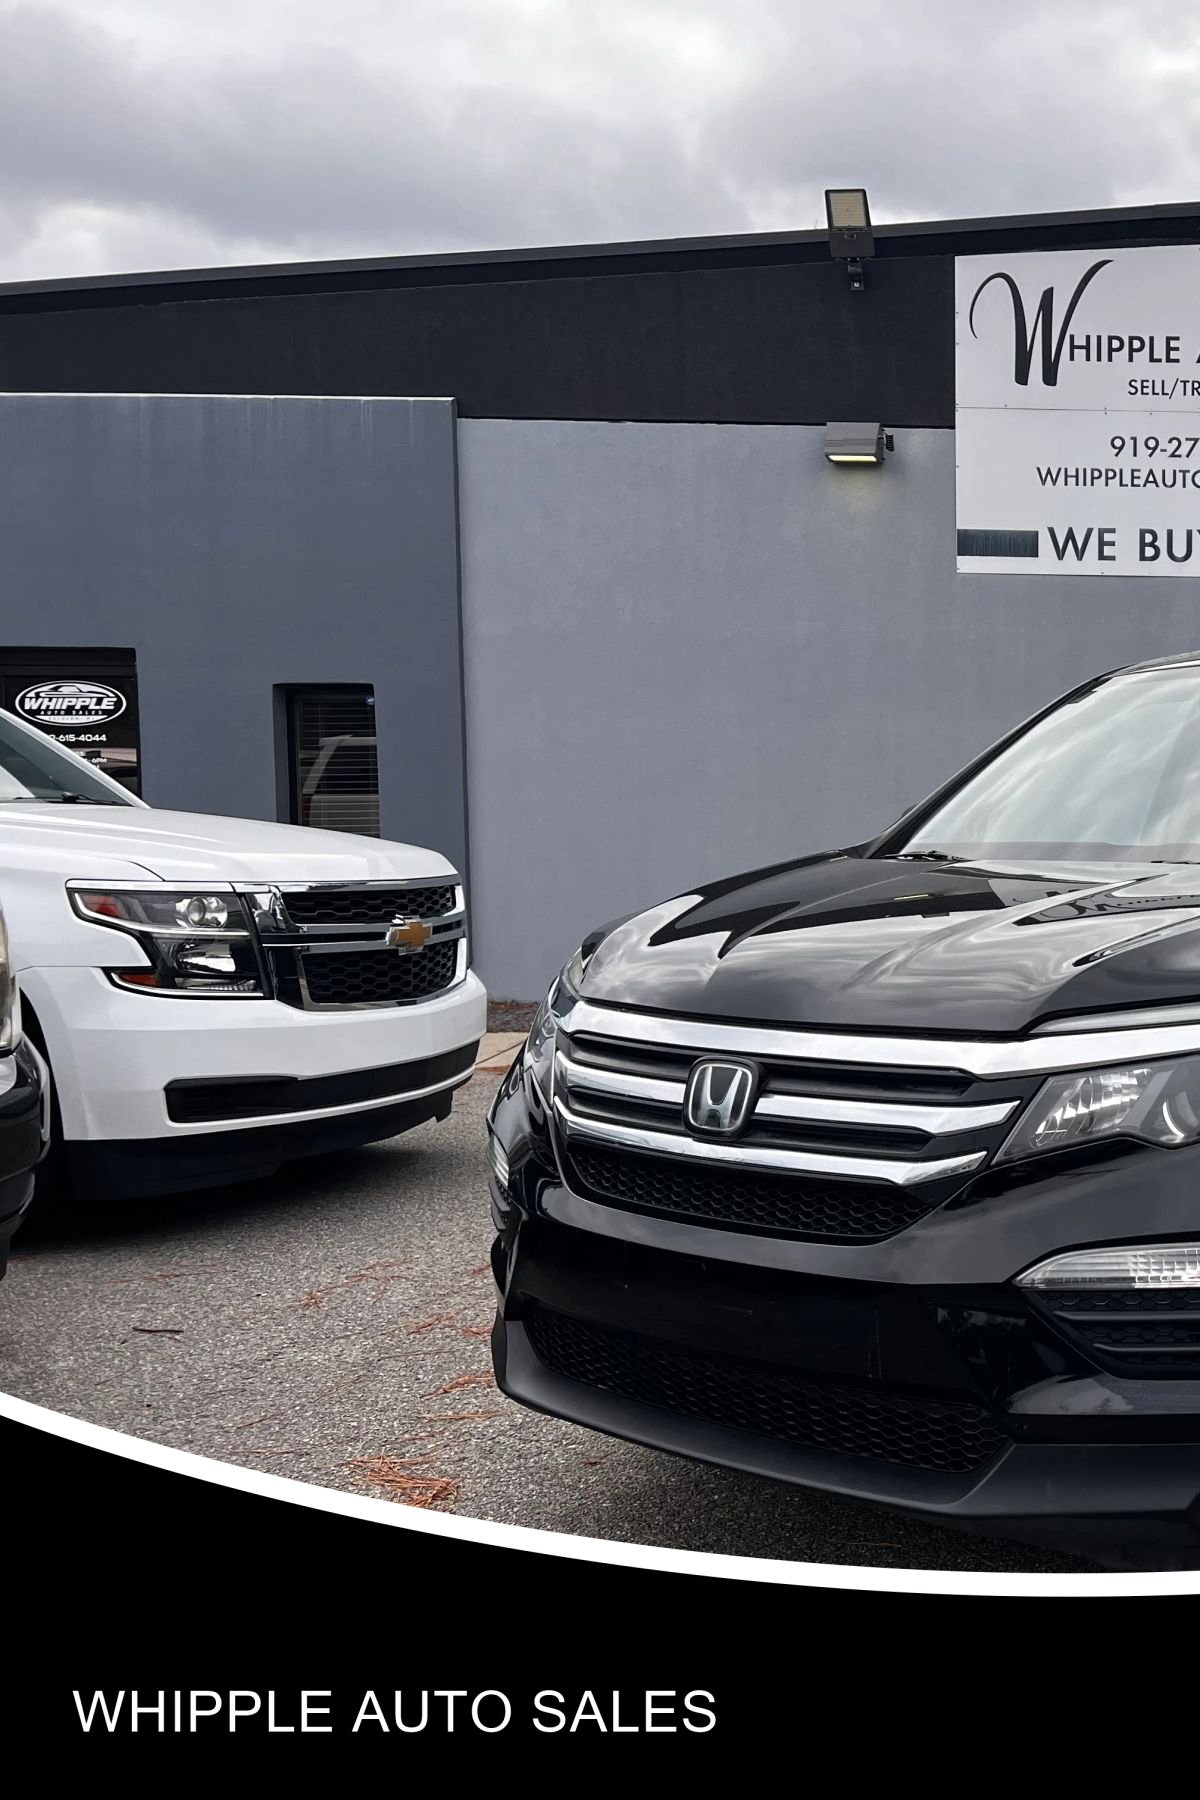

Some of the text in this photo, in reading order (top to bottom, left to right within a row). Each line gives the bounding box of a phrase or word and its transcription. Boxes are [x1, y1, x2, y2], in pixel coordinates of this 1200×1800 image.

[1047, 526, 1117, 562] WE
[24, 697, 118, 710] WHIPPLE
[48, 734, 107, 742] 9-615-4044
